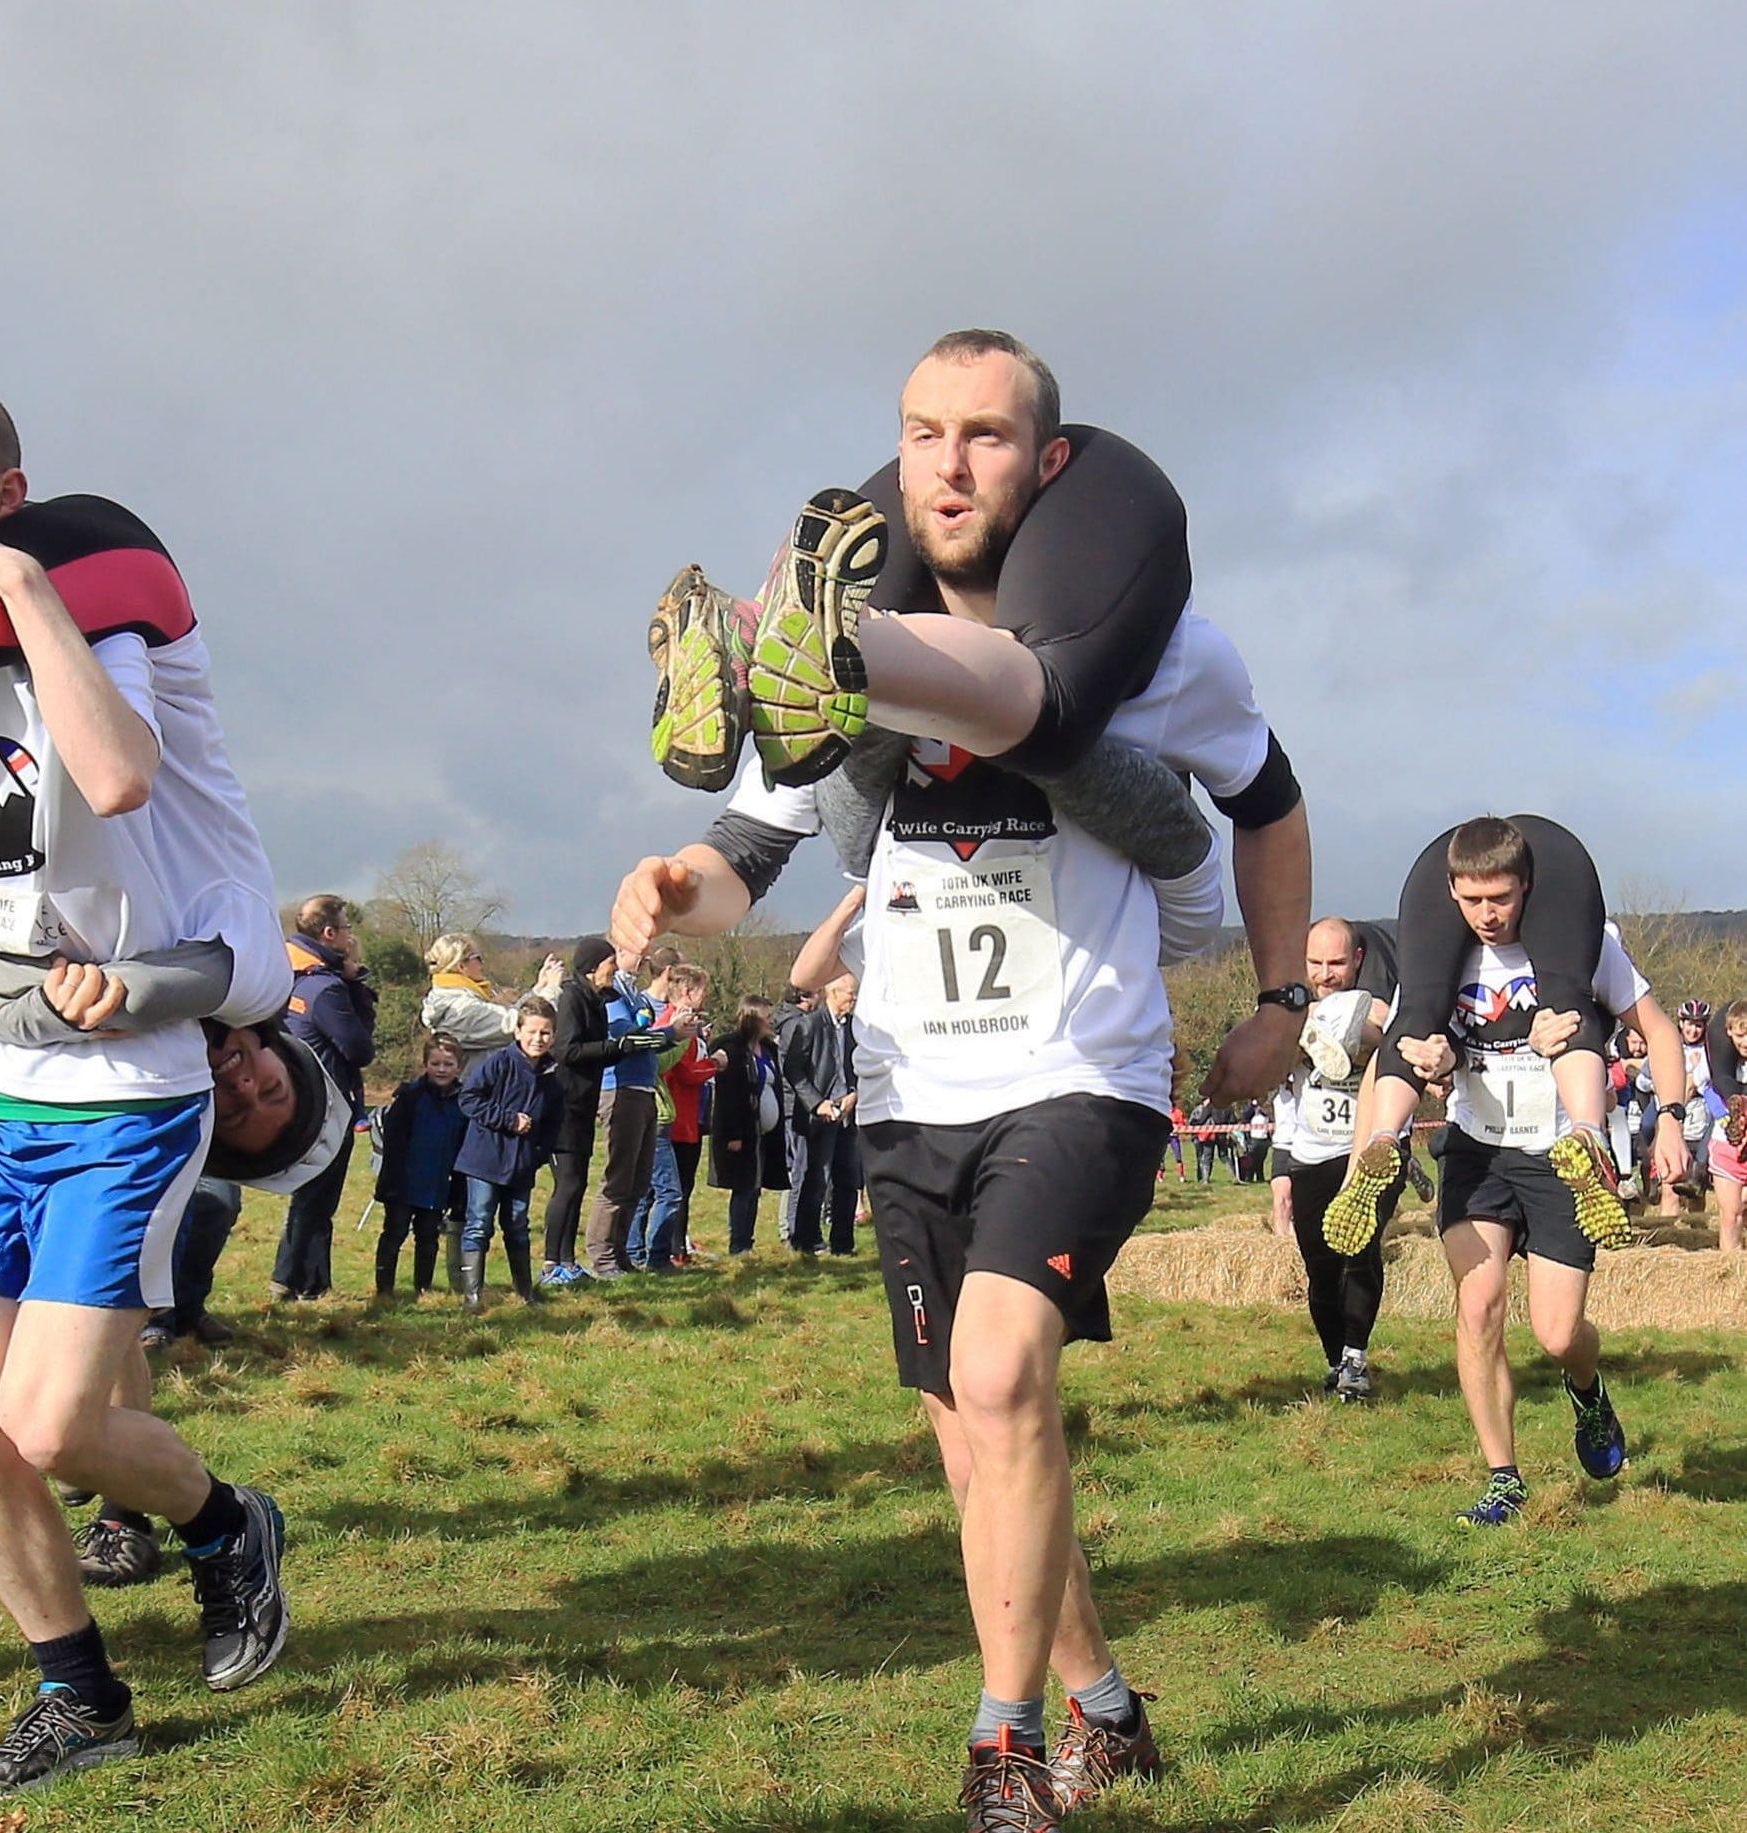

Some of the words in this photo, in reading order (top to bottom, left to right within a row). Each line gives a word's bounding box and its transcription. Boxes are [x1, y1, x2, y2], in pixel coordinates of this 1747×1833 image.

[898, 821, 937, 835] Wife
[1006, 817, 1046, 832] Race
[942, 876, 969, 890] 10TH
[972, 874, 989, 887] UK
[991, 870, 1023, 886] WIFE
[936, 893, 996, 909] CARRYING
[999, 888, 1032, 905] RACE
[937, 924, 1011, 1002] 12
[923, 1020, 948, 1035] IAN
[951, 1014, 1030, 1035] HOLBROOK
[1322, 1098, 1351, 1124] 34
